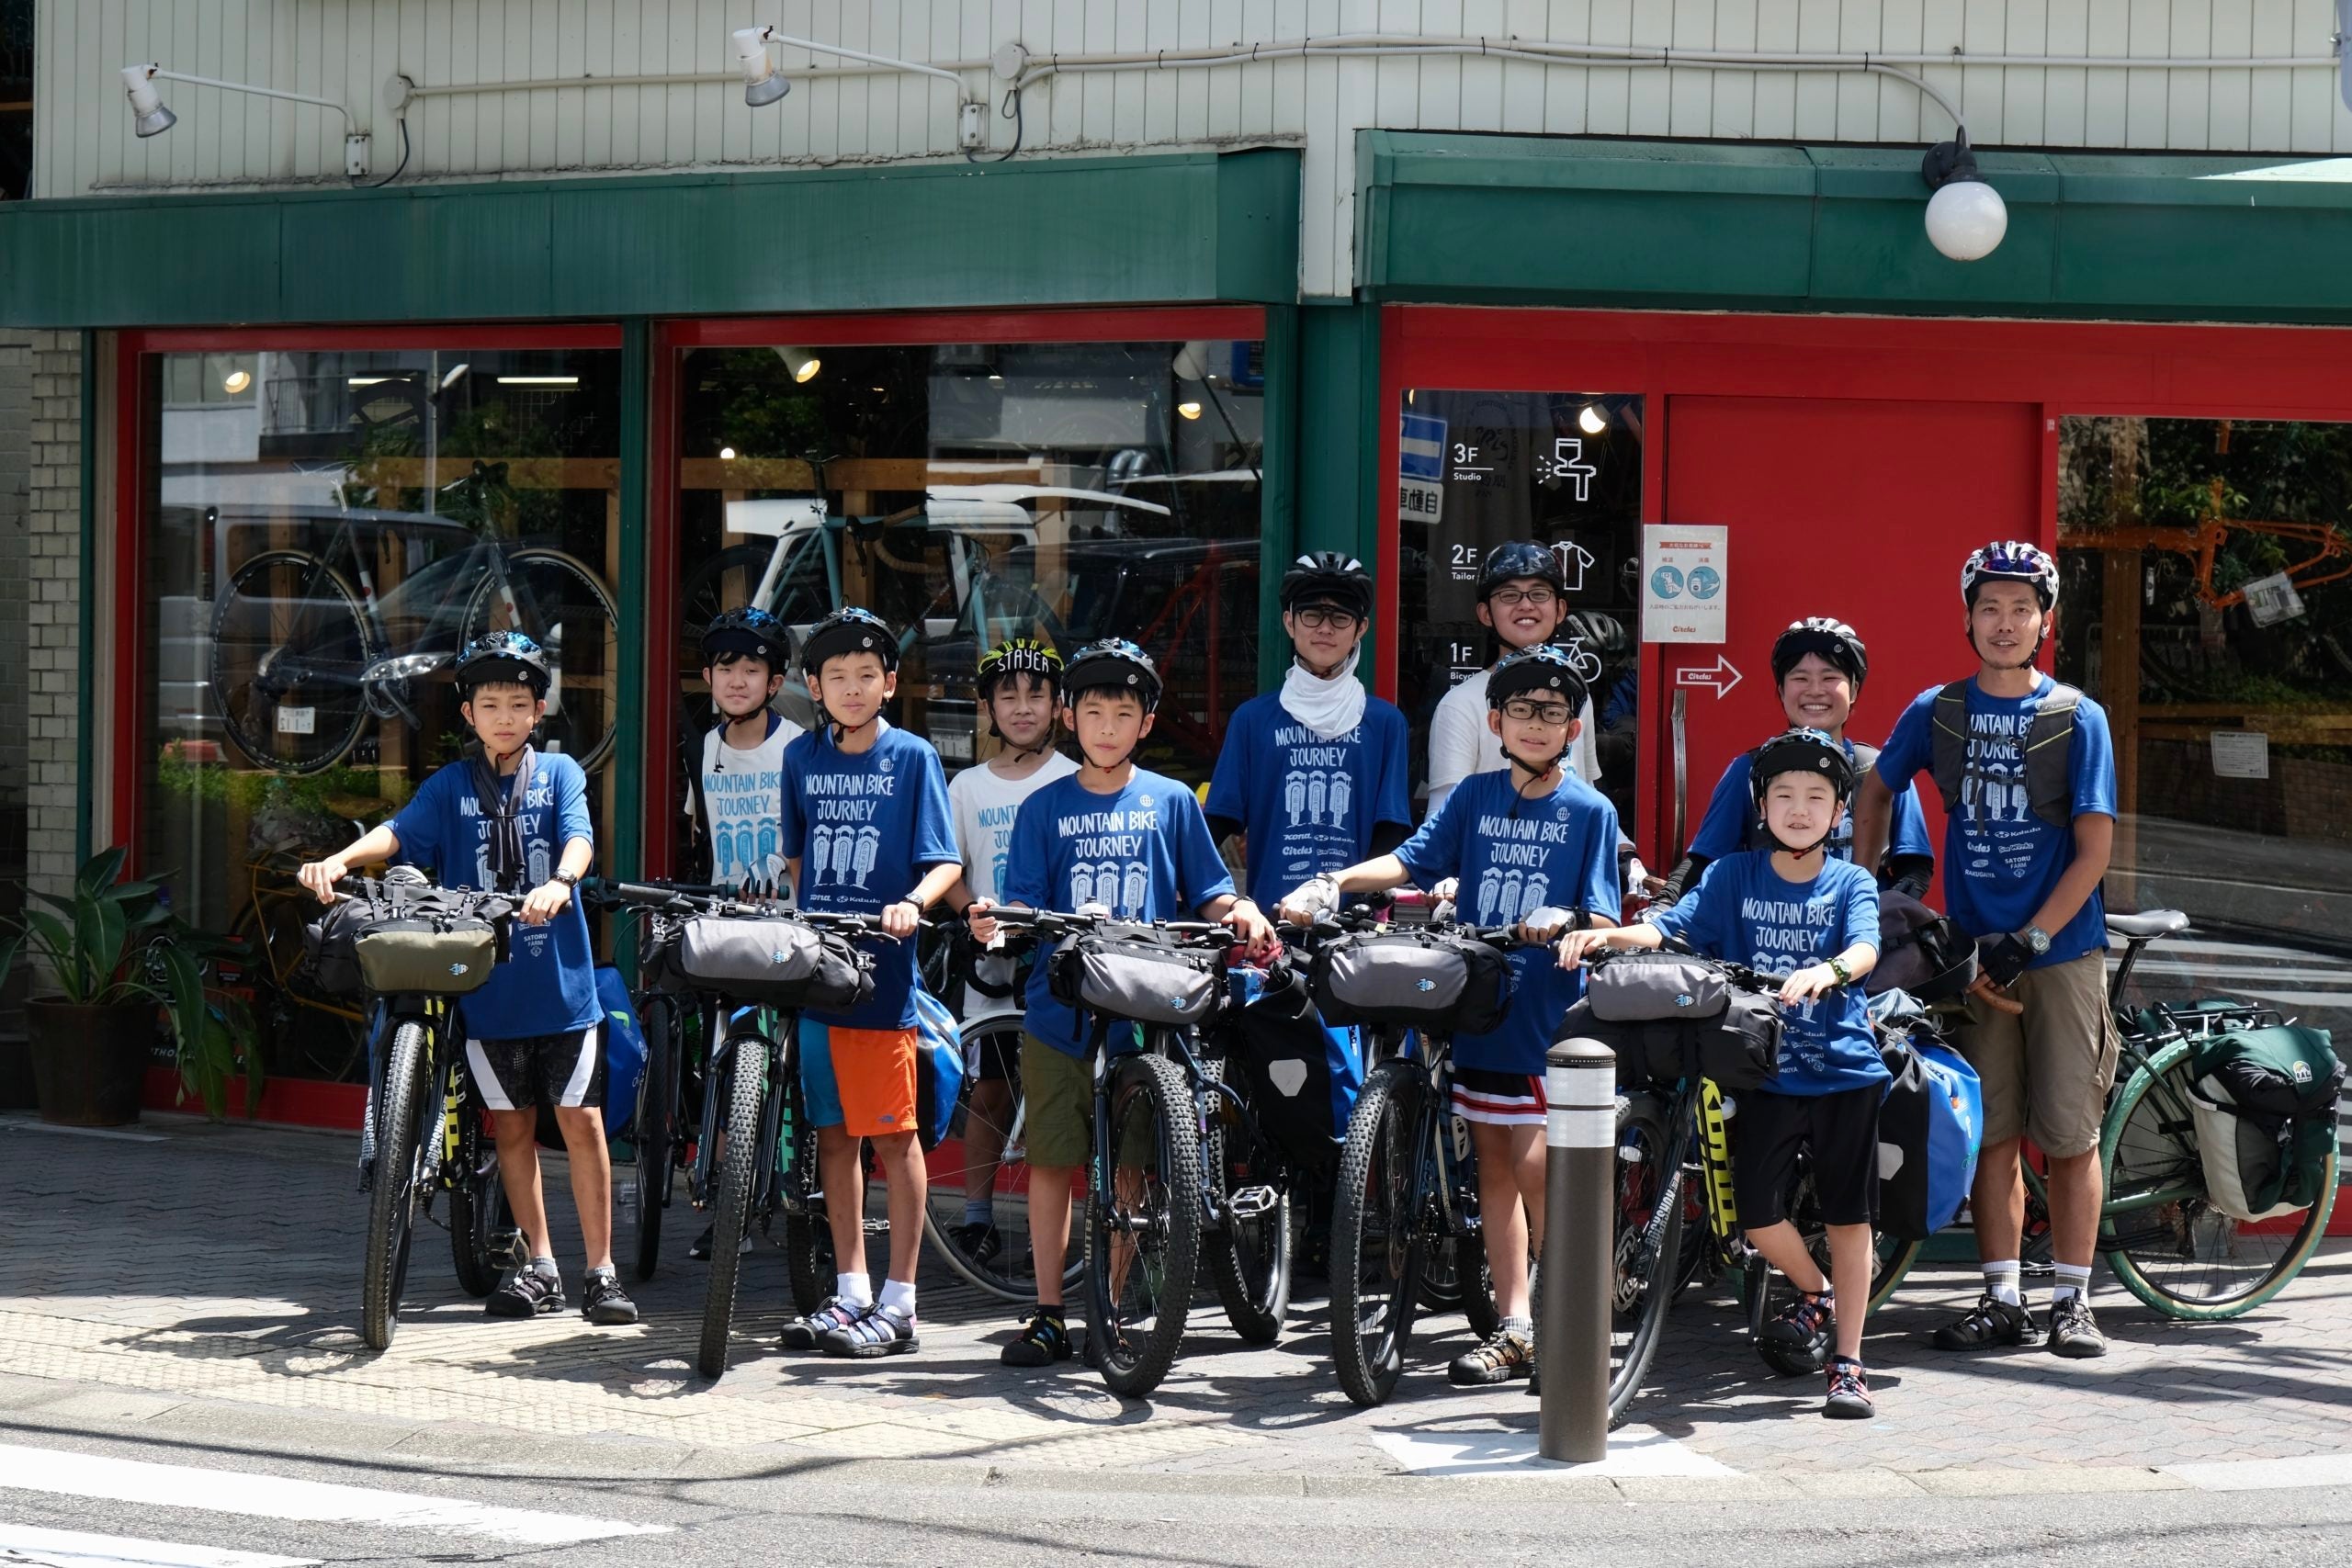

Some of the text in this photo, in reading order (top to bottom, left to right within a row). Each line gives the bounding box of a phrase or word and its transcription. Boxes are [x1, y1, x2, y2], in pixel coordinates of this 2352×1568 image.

[1453, 443, 1479, 463] 3F
[1453, 471, 1482, 481] Studio
[1452, 544, 1477, 564] 2F
[1451, 571, 1476, 581] Tailor
[997, 649, 1049, 673] STAYER
[1450, 642, 1473, 662] 1F
[1450, 671, 1476, 682] Bicycl
[1970, 714, 2014, 736] UNTAIN
[1289, 747, 1348, 767] JOURNEY
[704, 772, 783, 794] MOUNTAIN BIK
[805, 773, 895, 796] MOUNTAIN BIKE
[527, 787, 555, 809] BIKE
[718, 795, 771, 817] JOURNEY
[818, 800, 877, 822] JOURNEY
[978, 805, 1022, 828] MOUNT
[1058, 810, 1158, 838] MOUNTAIN BIKE
[1477, 815, 1569, 844] MOUNTAIN BIKE
[1075, 835, 1143, 862] JOURNEY
[1283, 846, 1313, 856] Circles
[1490, 841, 1551, 868] JOURNEY
[2005, 855, 2031, 864] SATORU
[1741, 897, 1836, 927] MOUNTAIN BIKE
[523, 933, 549, 944] SATORU
[1755, 925, 1818, 952] JOURNEY
[1087, 1192, 1095, 1216] TRAIL
[1084, 1218, 1093, 1260] WTB
